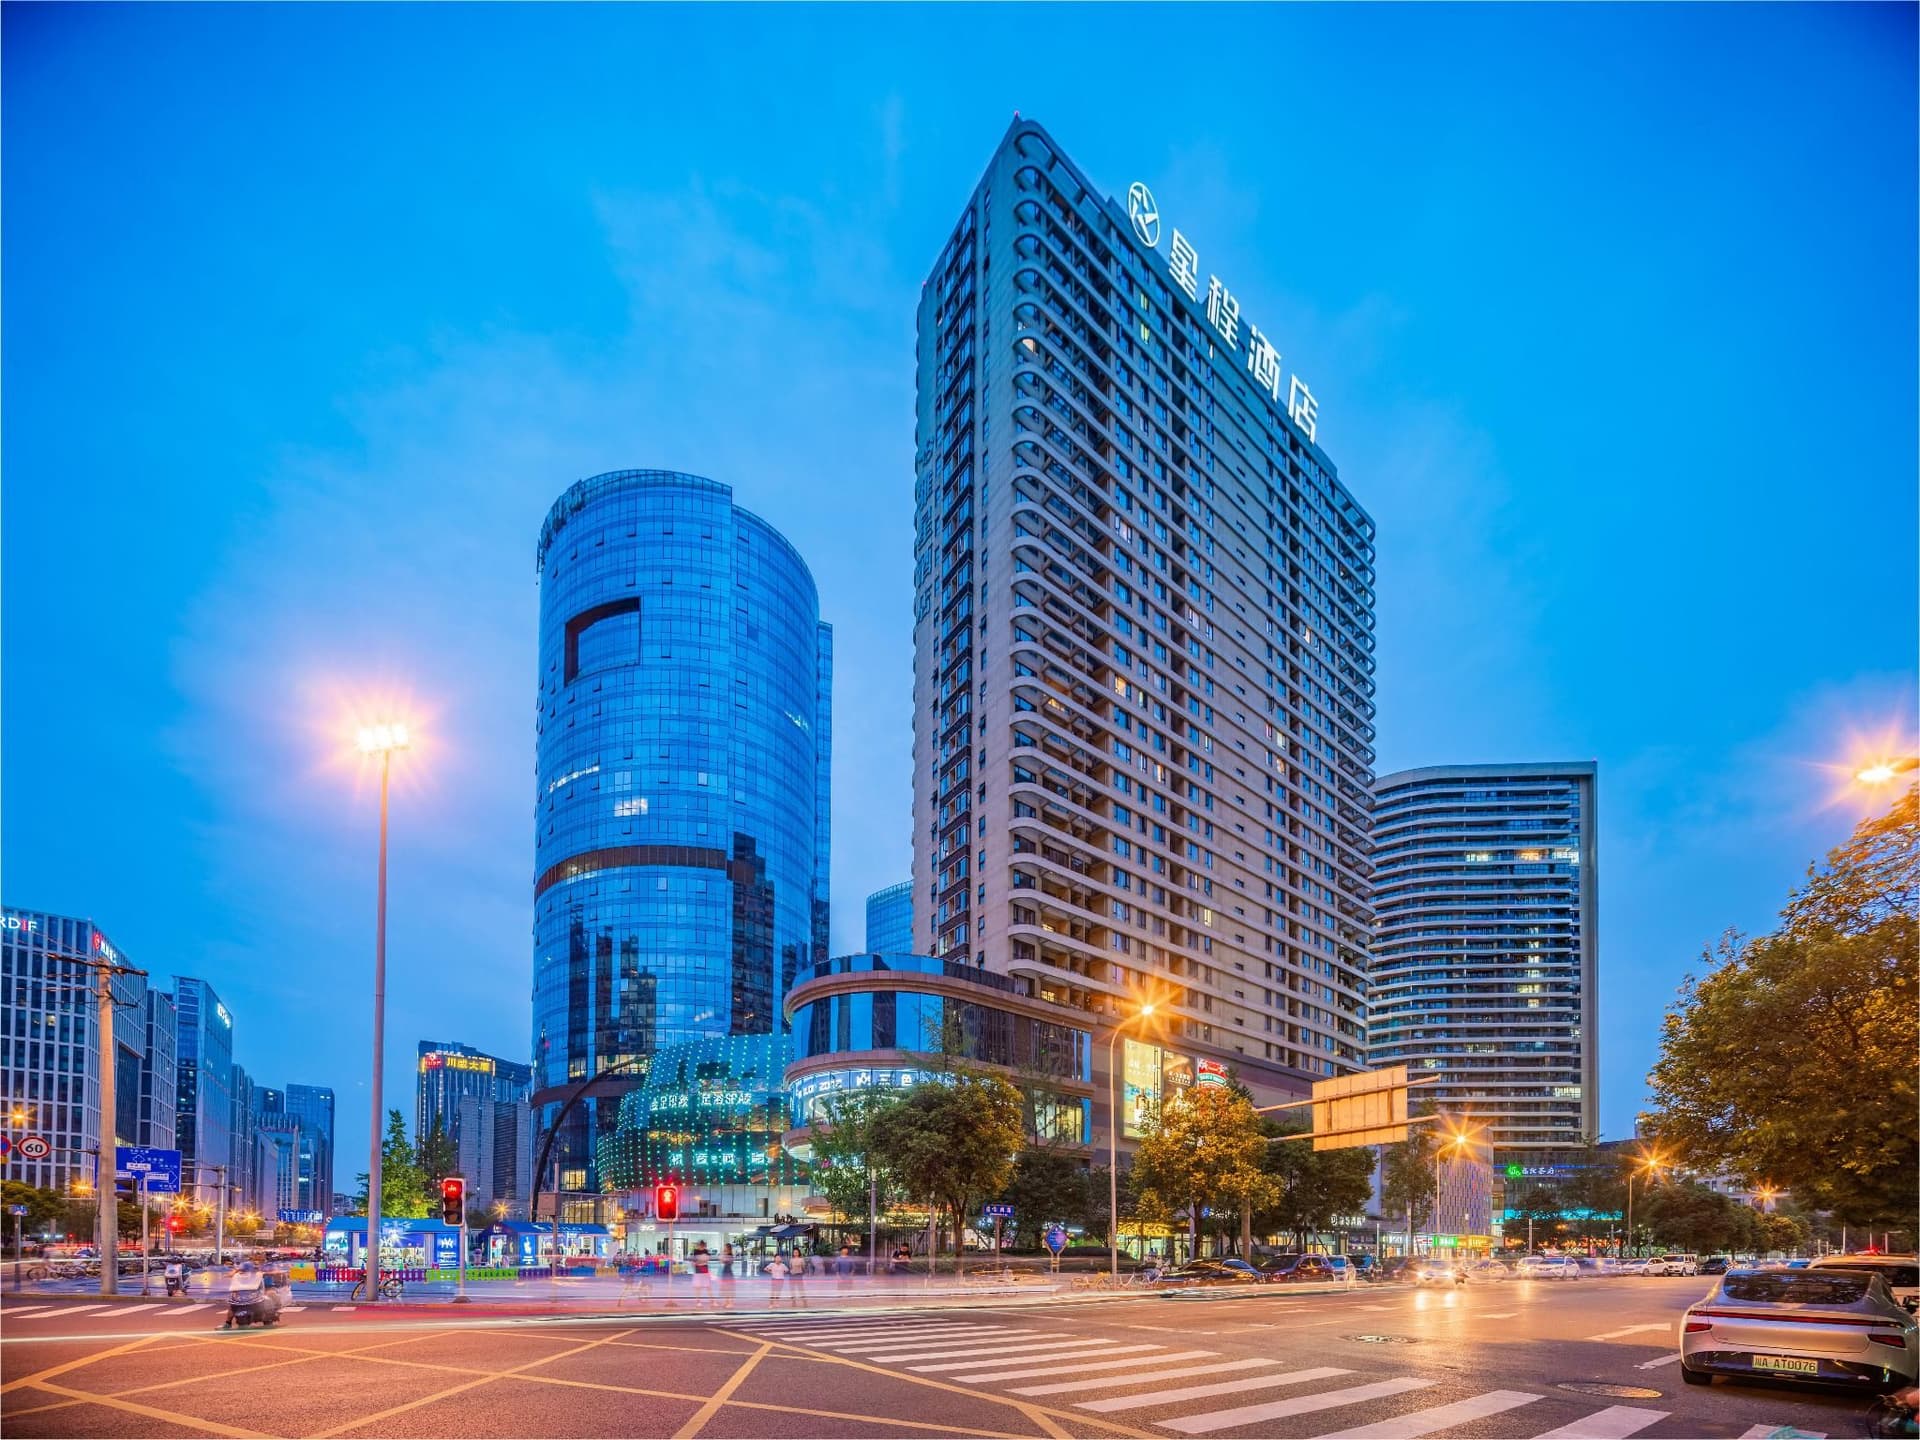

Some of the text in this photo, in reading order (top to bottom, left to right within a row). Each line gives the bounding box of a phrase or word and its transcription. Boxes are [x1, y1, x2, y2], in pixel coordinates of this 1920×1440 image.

[1168, 228, 1318, 444] 星程酒店
[25, 1143, 43, 1153] 60
